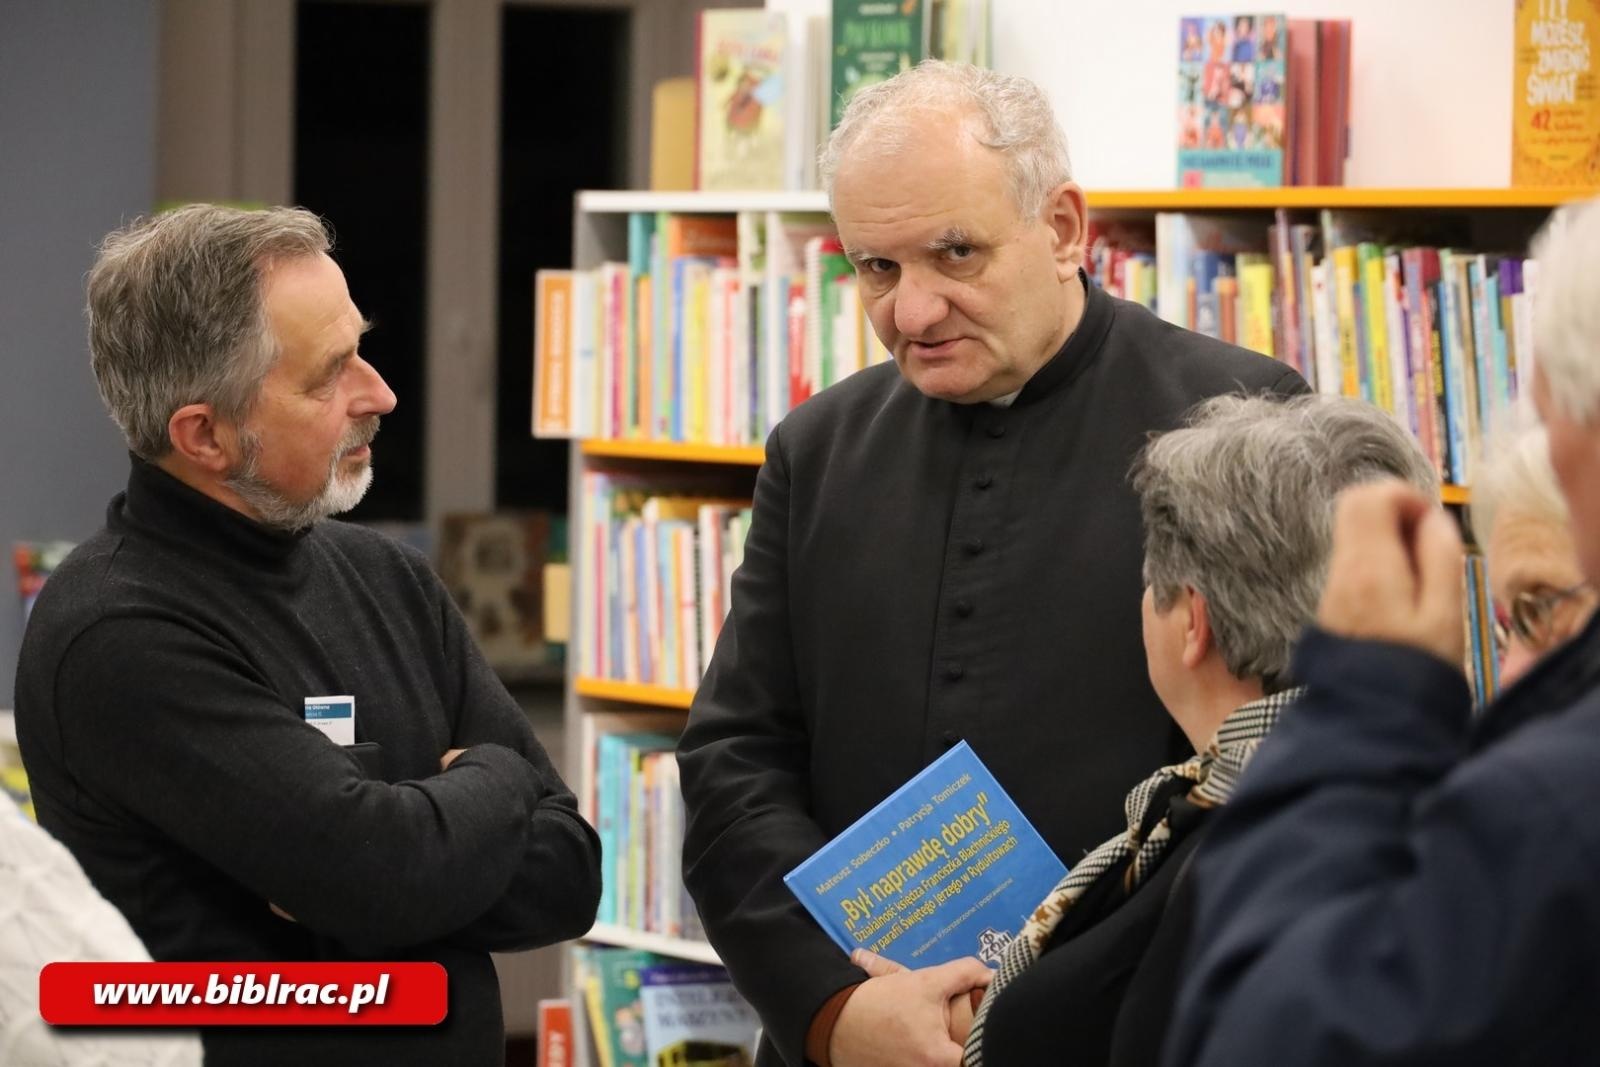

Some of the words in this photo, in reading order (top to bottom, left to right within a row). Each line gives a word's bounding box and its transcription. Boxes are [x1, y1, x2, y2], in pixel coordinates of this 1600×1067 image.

[1531, 109, 1550, 131] 42
[816, 867, 851, 894] Mateusz
[850, 837, 890, 868] Sobeczko
[898, 804, 933, 831] Patrycja
[932, 774, 971, 803] Tomiczek
[853, 905, 897, 942] Działalność
[894, 886, 925, 912] księdza
[921, 857, 962, 891] Franciszka
[958, 820, 1010, 862] Blachnickiego
[869, 838, 949, 902] naprawdę
[870, 944, 879, 956] w
[877, 922, 904, 949] parafii
[898, 900, 936, 929] Świętego
[934, 880, 963, 905] Jerzego
[961, 873, 970, 883] w
[967, 836, 1017, 877] Rydułtowach
